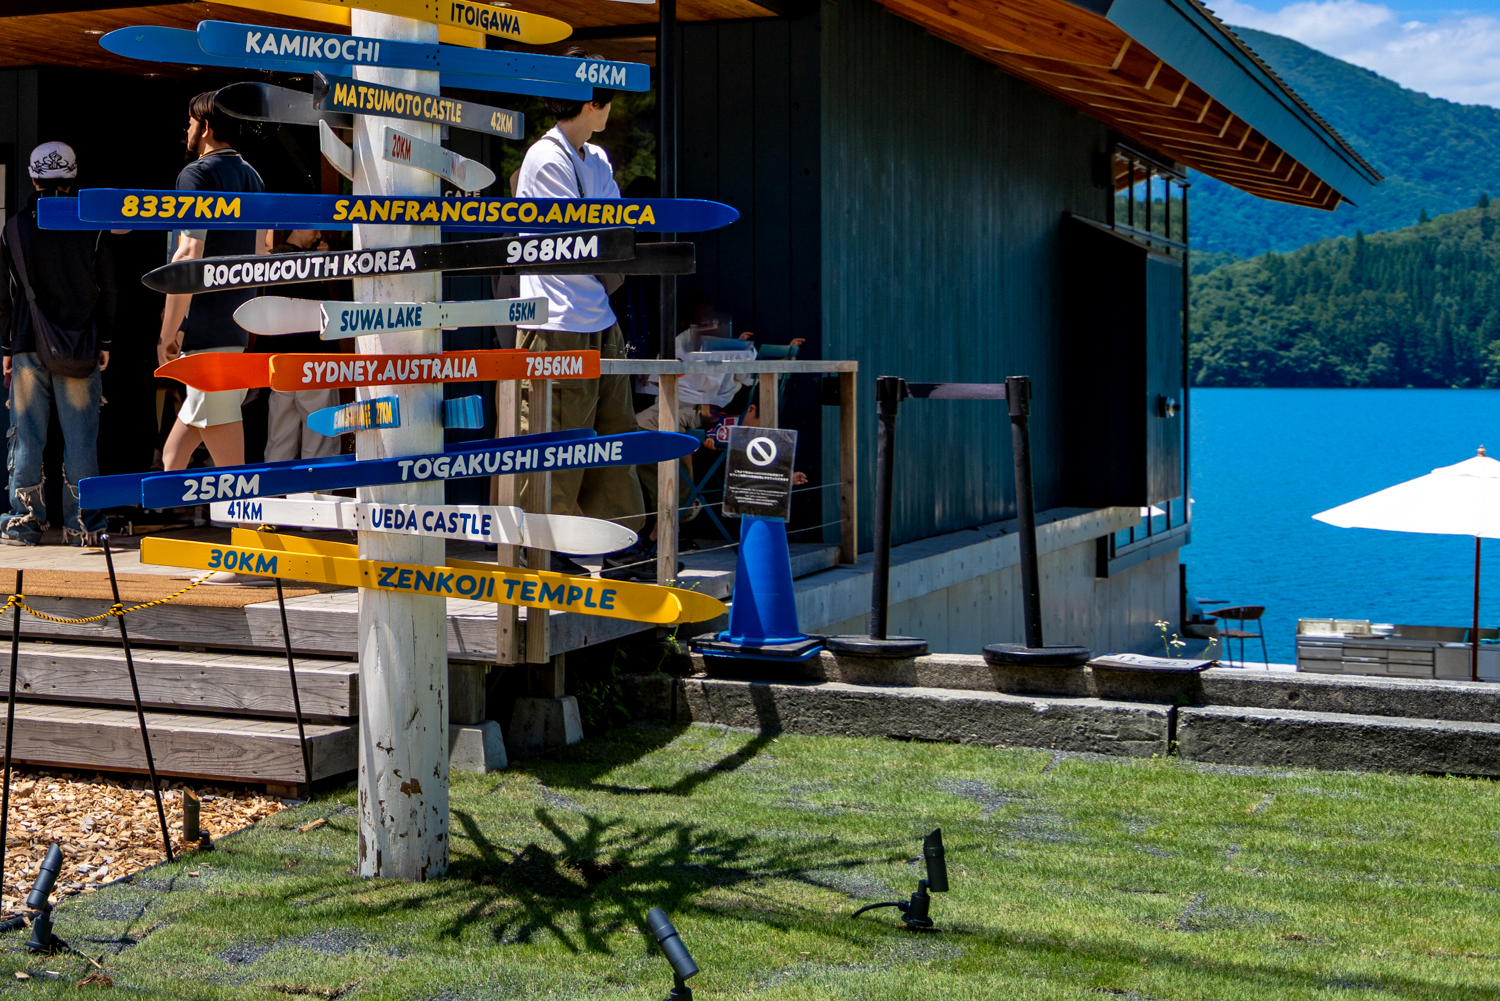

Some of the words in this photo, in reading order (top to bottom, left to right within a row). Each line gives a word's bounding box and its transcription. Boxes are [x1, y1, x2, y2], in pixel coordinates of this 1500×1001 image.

[451, 2, 521, 36] ITOIGAWA
[245, 31, 380, 63] KAMIKOCHI
[575, 61, 626, 87] 46KM
[333, 83, 422, 116] MATSUMOTO
[423, 97, 462, 123] CASTLE
[490, 111, 513, 134] 42KM
[391, 133, 412, 162] 20KM
[121, 195, 241, 219] 8337KM
[333, 199, 656, 225] SANFRANCISCO.AMERICA
[343, 249, 417, 274] KOREA
[506, 235, 599, 264] 968KM
[340, 309, 385, 332] SUWA
[387, 306, 422, 328] LAKE
[509, 302, 536, 322] 65KM
[301, 357, 478, 384] SYDNEY.AUSTRALIA
[525, 356, 583, 377] 7956KM
[398, 449, 539, 482] TOGAKUSHI
[543, 441, 624, 468] SHRINE
[227, 500, 263, 521] 41KM
[371, 508, 418, 531] UEDA
[422, 511, 492, 536] CASTLE
[208, 549, 278, 575] 30KM
[377, 566, 495, 600] ZENKOJI
[503, 579, 617, 610] TEMPLE
